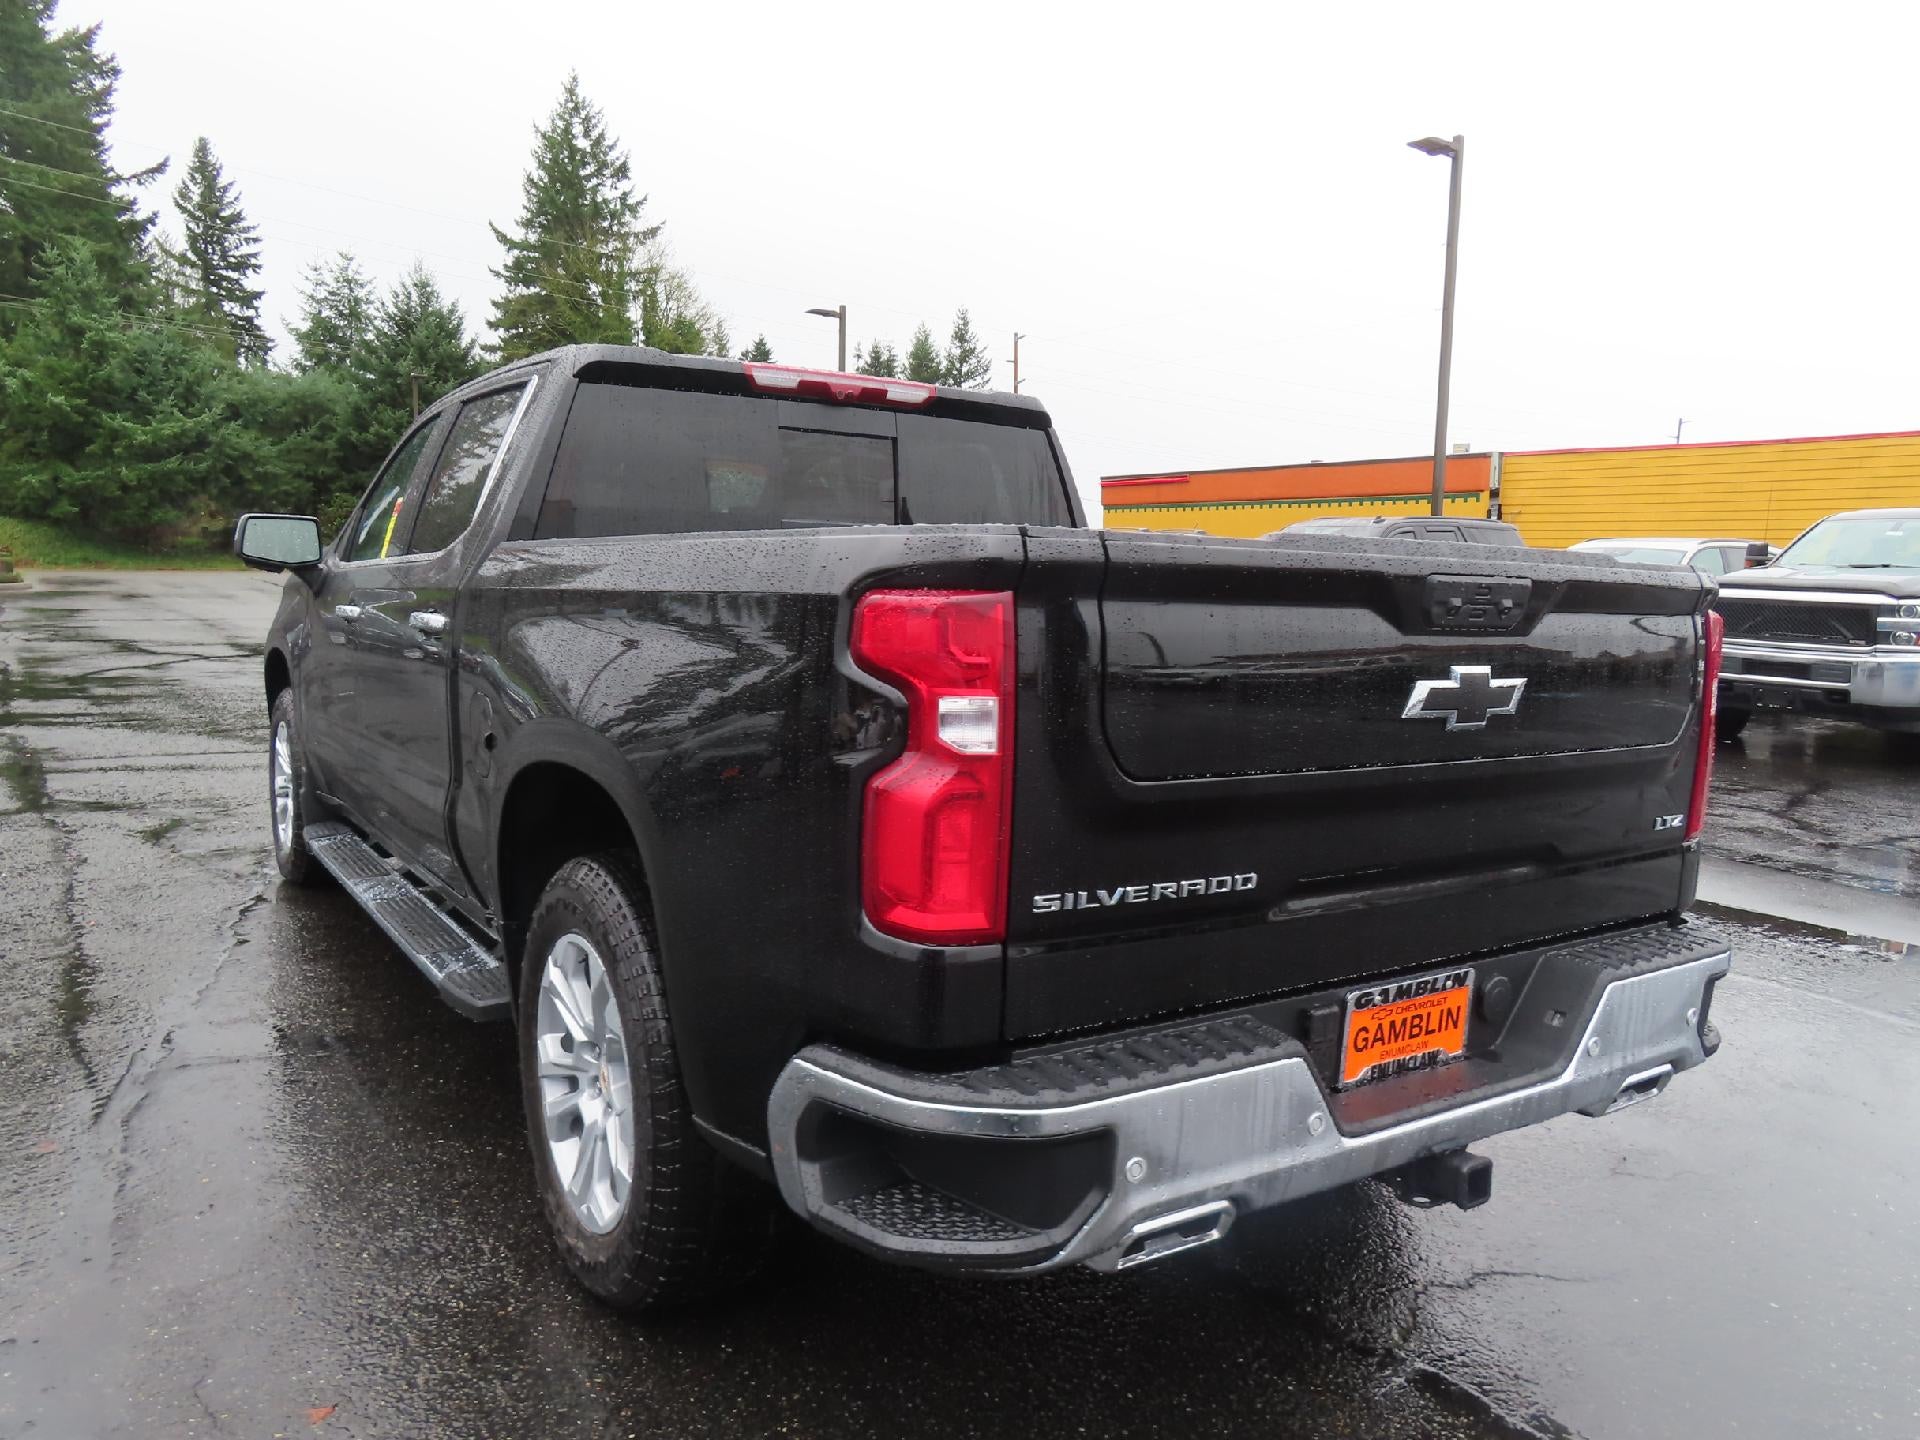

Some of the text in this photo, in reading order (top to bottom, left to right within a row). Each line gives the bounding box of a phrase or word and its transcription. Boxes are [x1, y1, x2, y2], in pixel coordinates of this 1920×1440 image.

[1654, 814, 1684, 831] LTZ
[1032, 872, 1257, 913] SILVERADO
[1354, 970, 1469, 1010] GAMBLIN
[1395, 997, 1449, 1015] CHEVROLET
[1353, 1005, 1462, 1053] GAMBLIN
